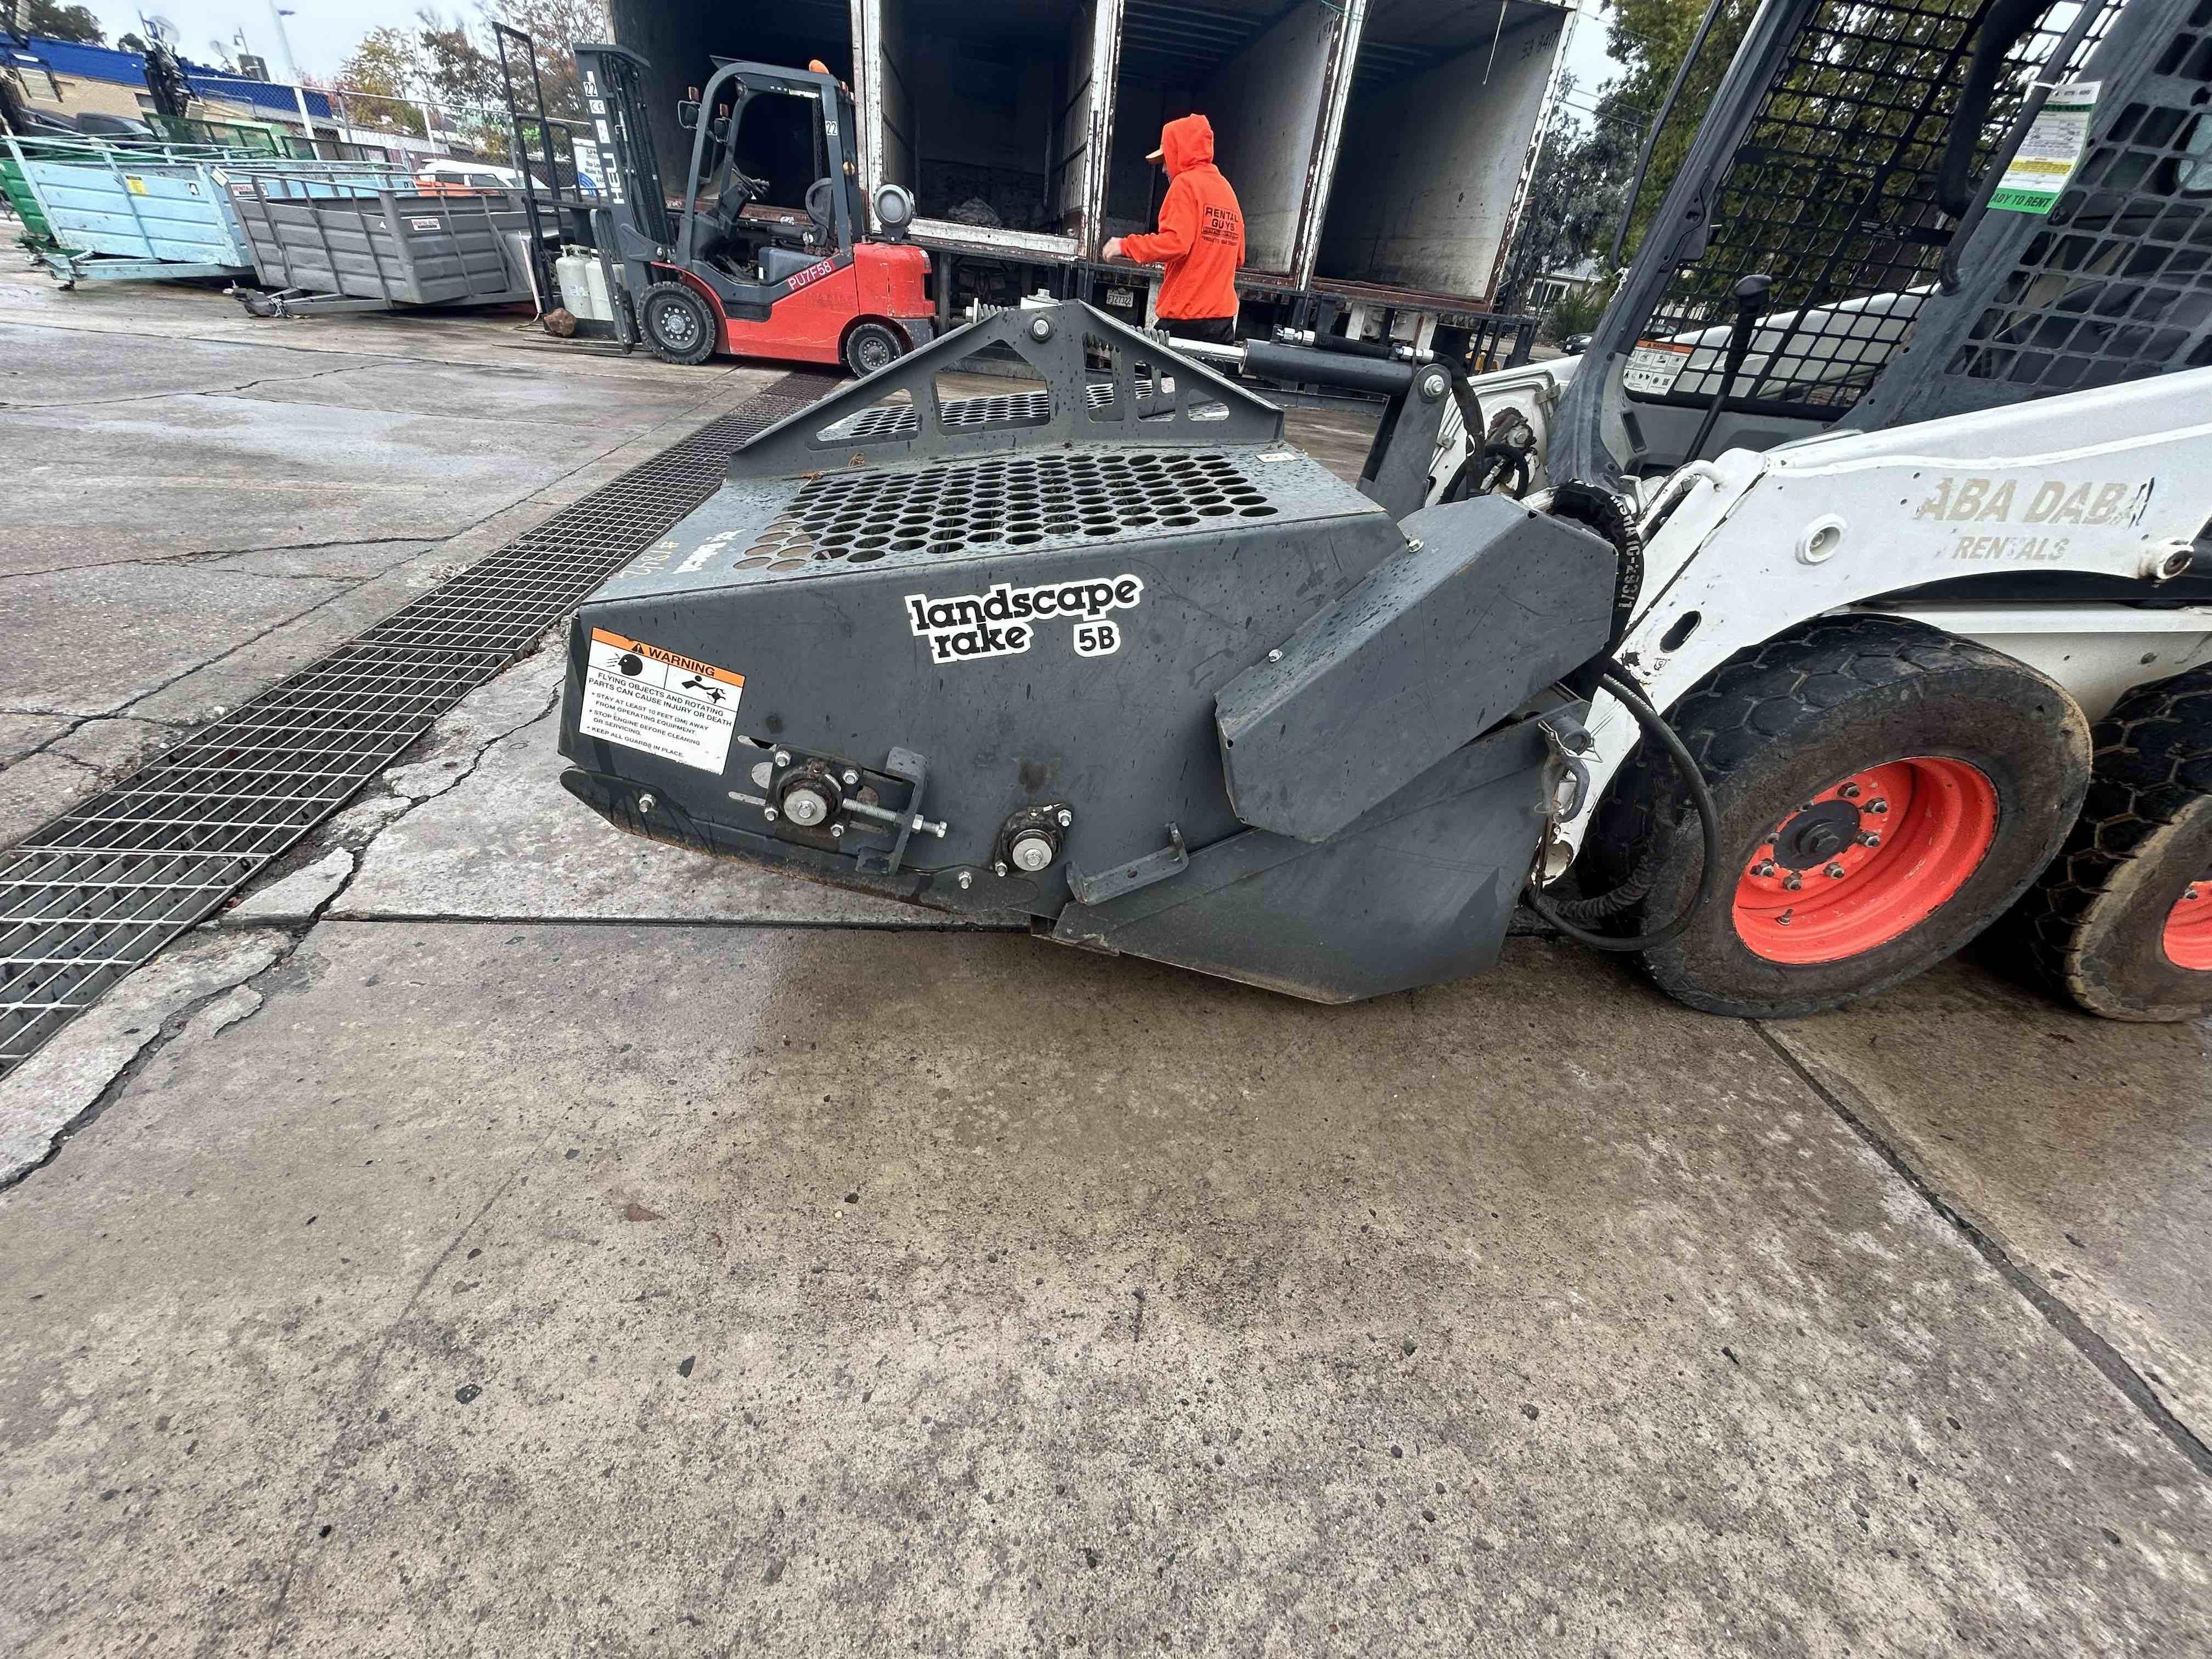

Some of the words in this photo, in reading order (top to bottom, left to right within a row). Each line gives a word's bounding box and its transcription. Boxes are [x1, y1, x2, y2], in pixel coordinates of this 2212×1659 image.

[585, 82, 597, 95] 22
[826, 121, 837, 134] 22
[1205, 206, 1238, 223] RENTAL
[2012, 194, 2025, 206] TO
[2024, 195, 2052, 208] RENT
[1211, 218, 1235, 231] GUYS
[788, 261, 832, 290] PU7F58
[911, 579, 1137, 631] landscape
[934, 623, 1026, 658] rake
[1079, 625, 1115, 652] 5B
[647, 646, 716, 677] WARNING
[588, 677, 614, 691] PARTS
[616, 686, 633, 697] CAN
[634, 692, 662, 706] CAUSE
[663, 701, 691, 714] INJURY
[693, 710, 704, 719] OR
[706, 714, 732, 727] DEATH
[597, 672, 627, 686] FLYING
[628, 681, 664, 698] OBJECTS
[666, 693, 682, 704] AND
[684, 699, 724, 716] ROTATING
[595, 700, 615, 710] FROM
[617, 706, 655, 723] OPERATING
[596, 692, 613, 702] STAY
[625, 701, 646, 712] LEAST
[656, 710, 673, 720] FEET
[689, 721, 708, 731] AWAY
[591, 726, 609, 736] KEEP
[611, 731, 623, 740] ALL
[594, 709, 612, 719] STOP
[613, 715, 638, 727] ENGINE
[640, 723, 666, 735] BEFORE
[667, 731, 701, 746] CLEANING
